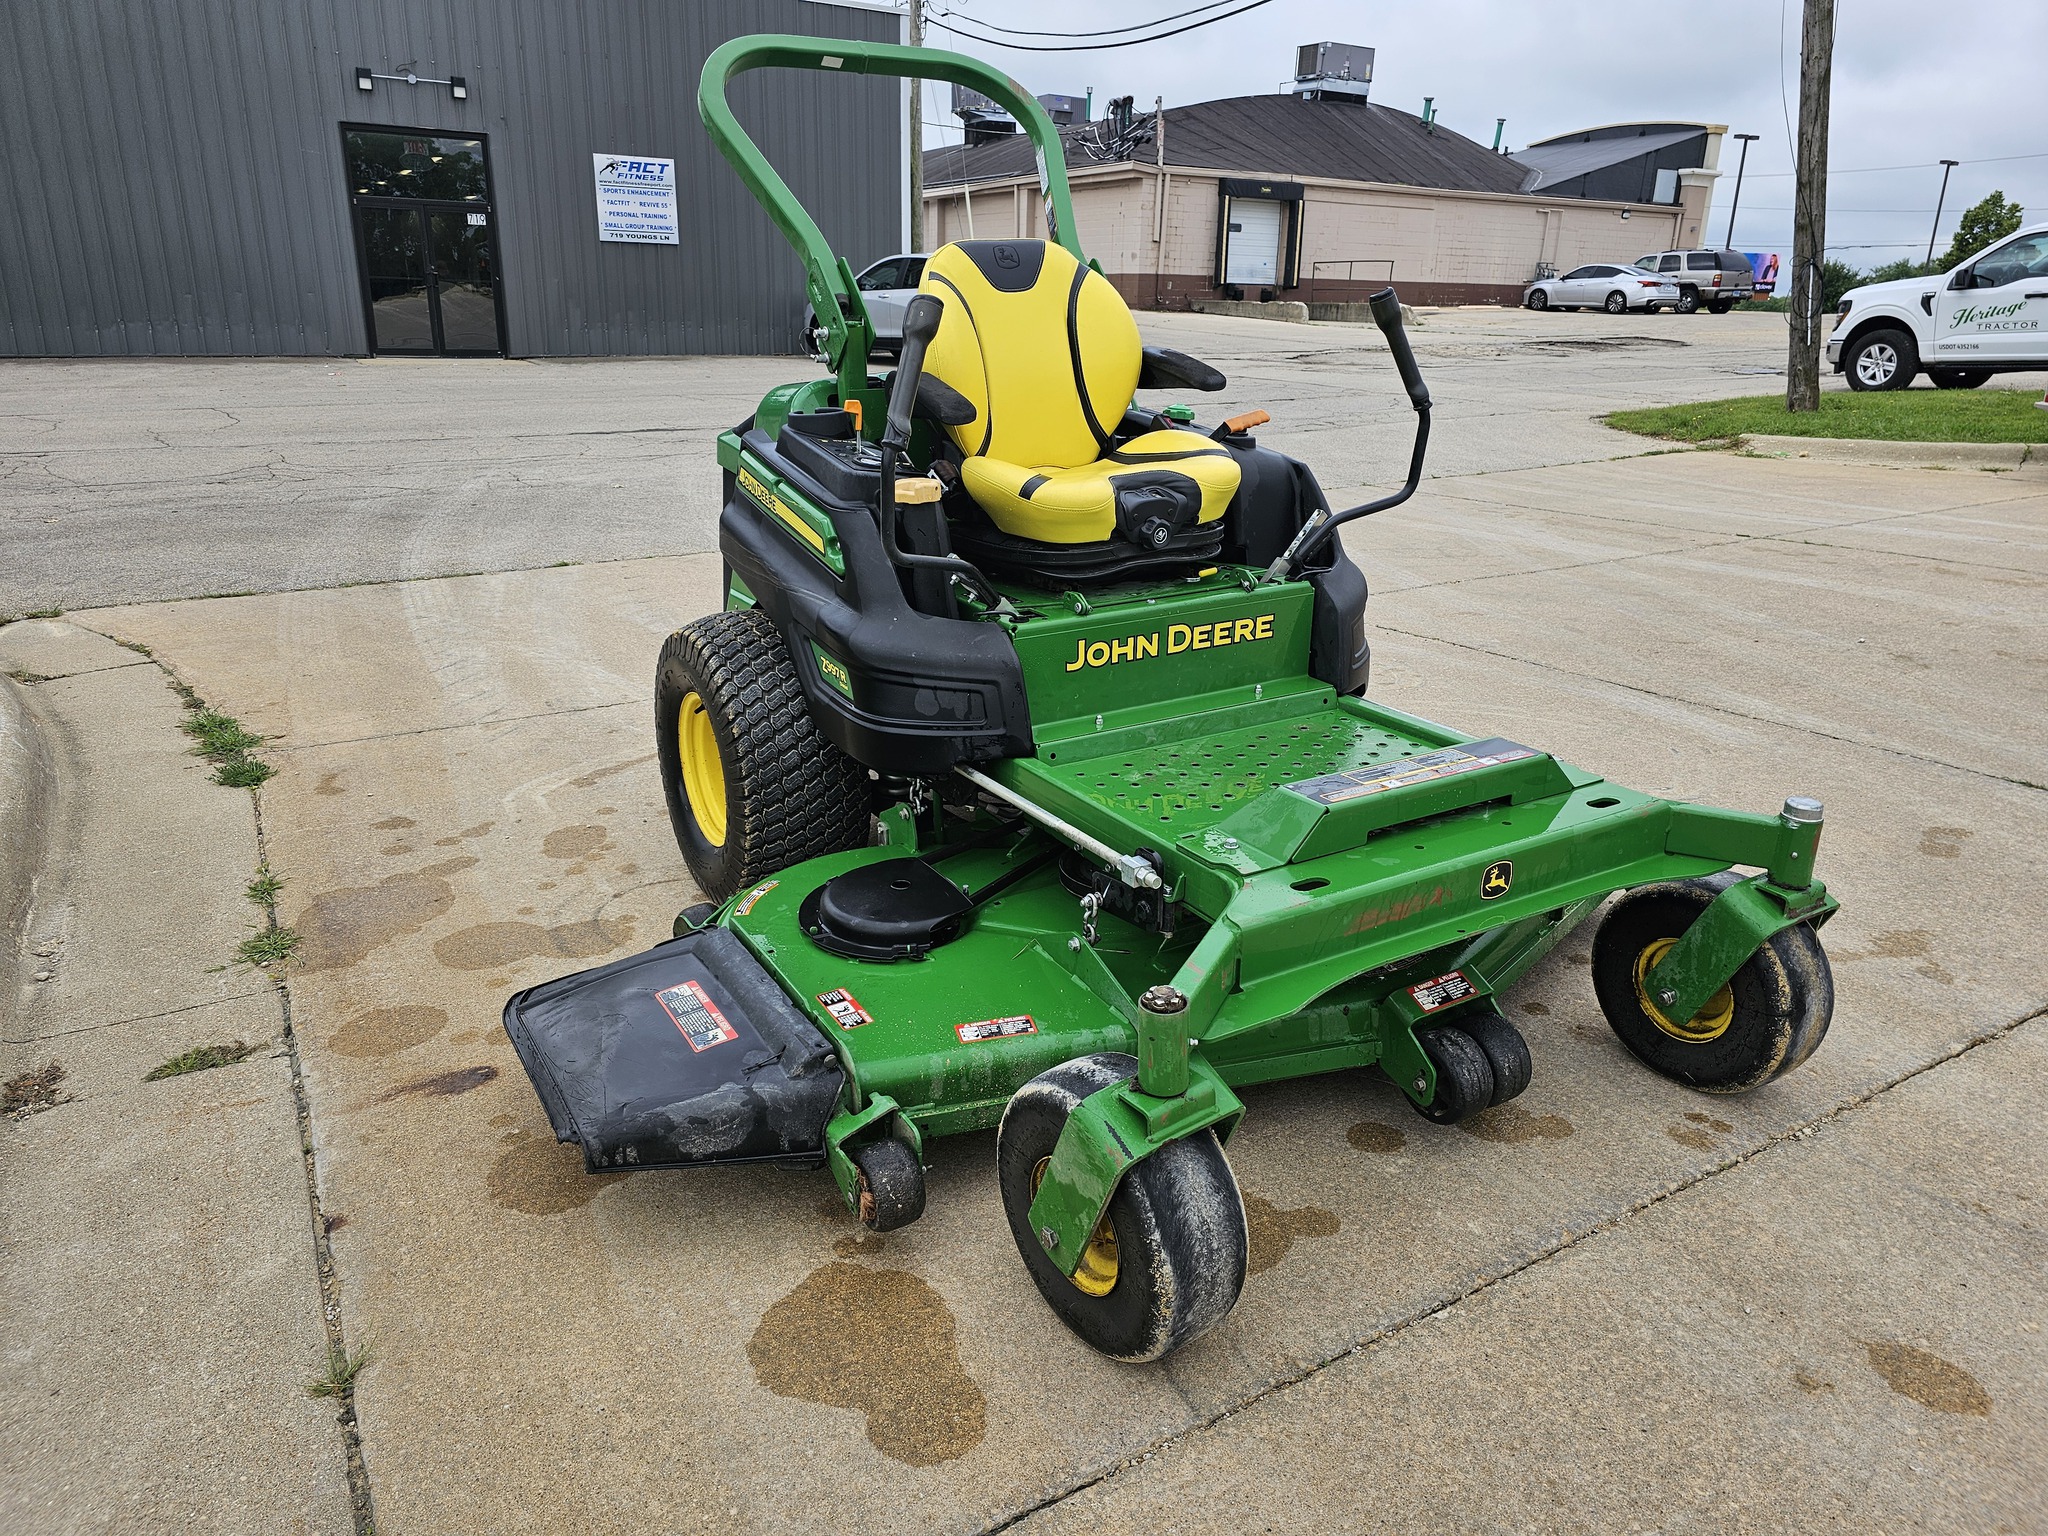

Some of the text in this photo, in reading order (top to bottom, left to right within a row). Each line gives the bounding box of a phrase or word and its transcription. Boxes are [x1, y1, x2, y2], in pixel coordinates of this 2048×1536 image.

[615, 160, 670, 174] FACT
[617, 172, 664, 182] FITNESS
[627, 189, 670, 197] ENHANCEMENT
[607, 199, 630, 207] FACTFIT
[468, 213, 486, 225] 719
[608, 210, 668, 220] PERSONAL TRAINING
[1949, 301, 2028, 329] Heritage
[1976, 321, 2039, 330] TRACTOR
[1065, 613, 1275, 673] JOHN DEERE
